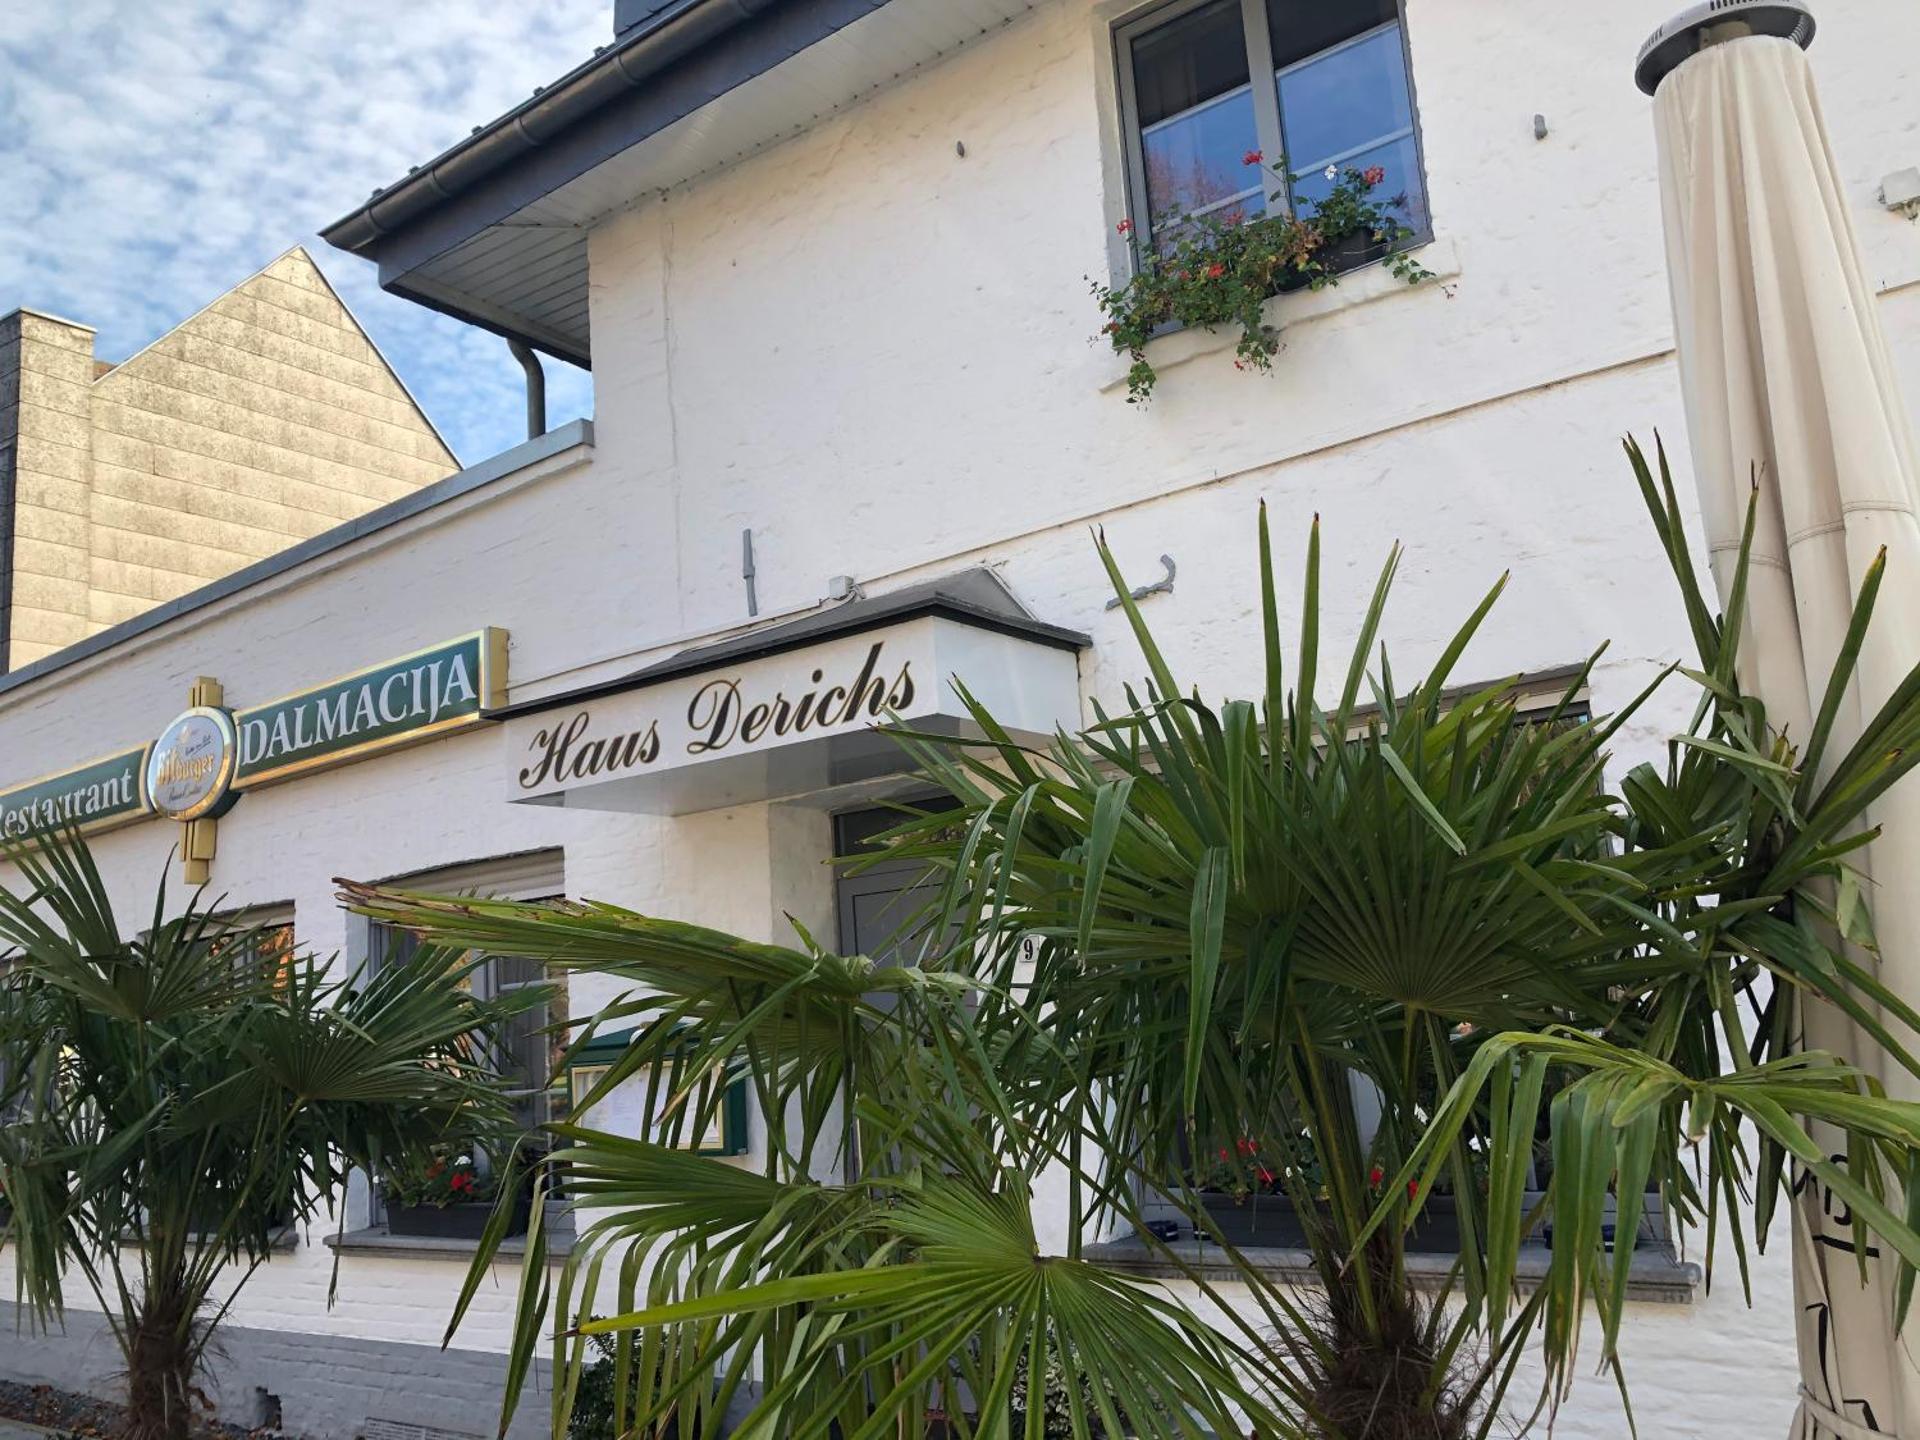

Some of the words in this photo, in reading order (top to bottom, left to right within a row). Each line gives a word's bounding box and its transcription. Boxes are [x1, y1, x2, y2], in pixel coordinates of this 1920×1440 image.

[240, 652, 478, 766] DALMACIJA
[518, 711, 661, 790] Haus
[686, 640, 916, 755] Derichs
[1023, 938, 1034, 961] 9
